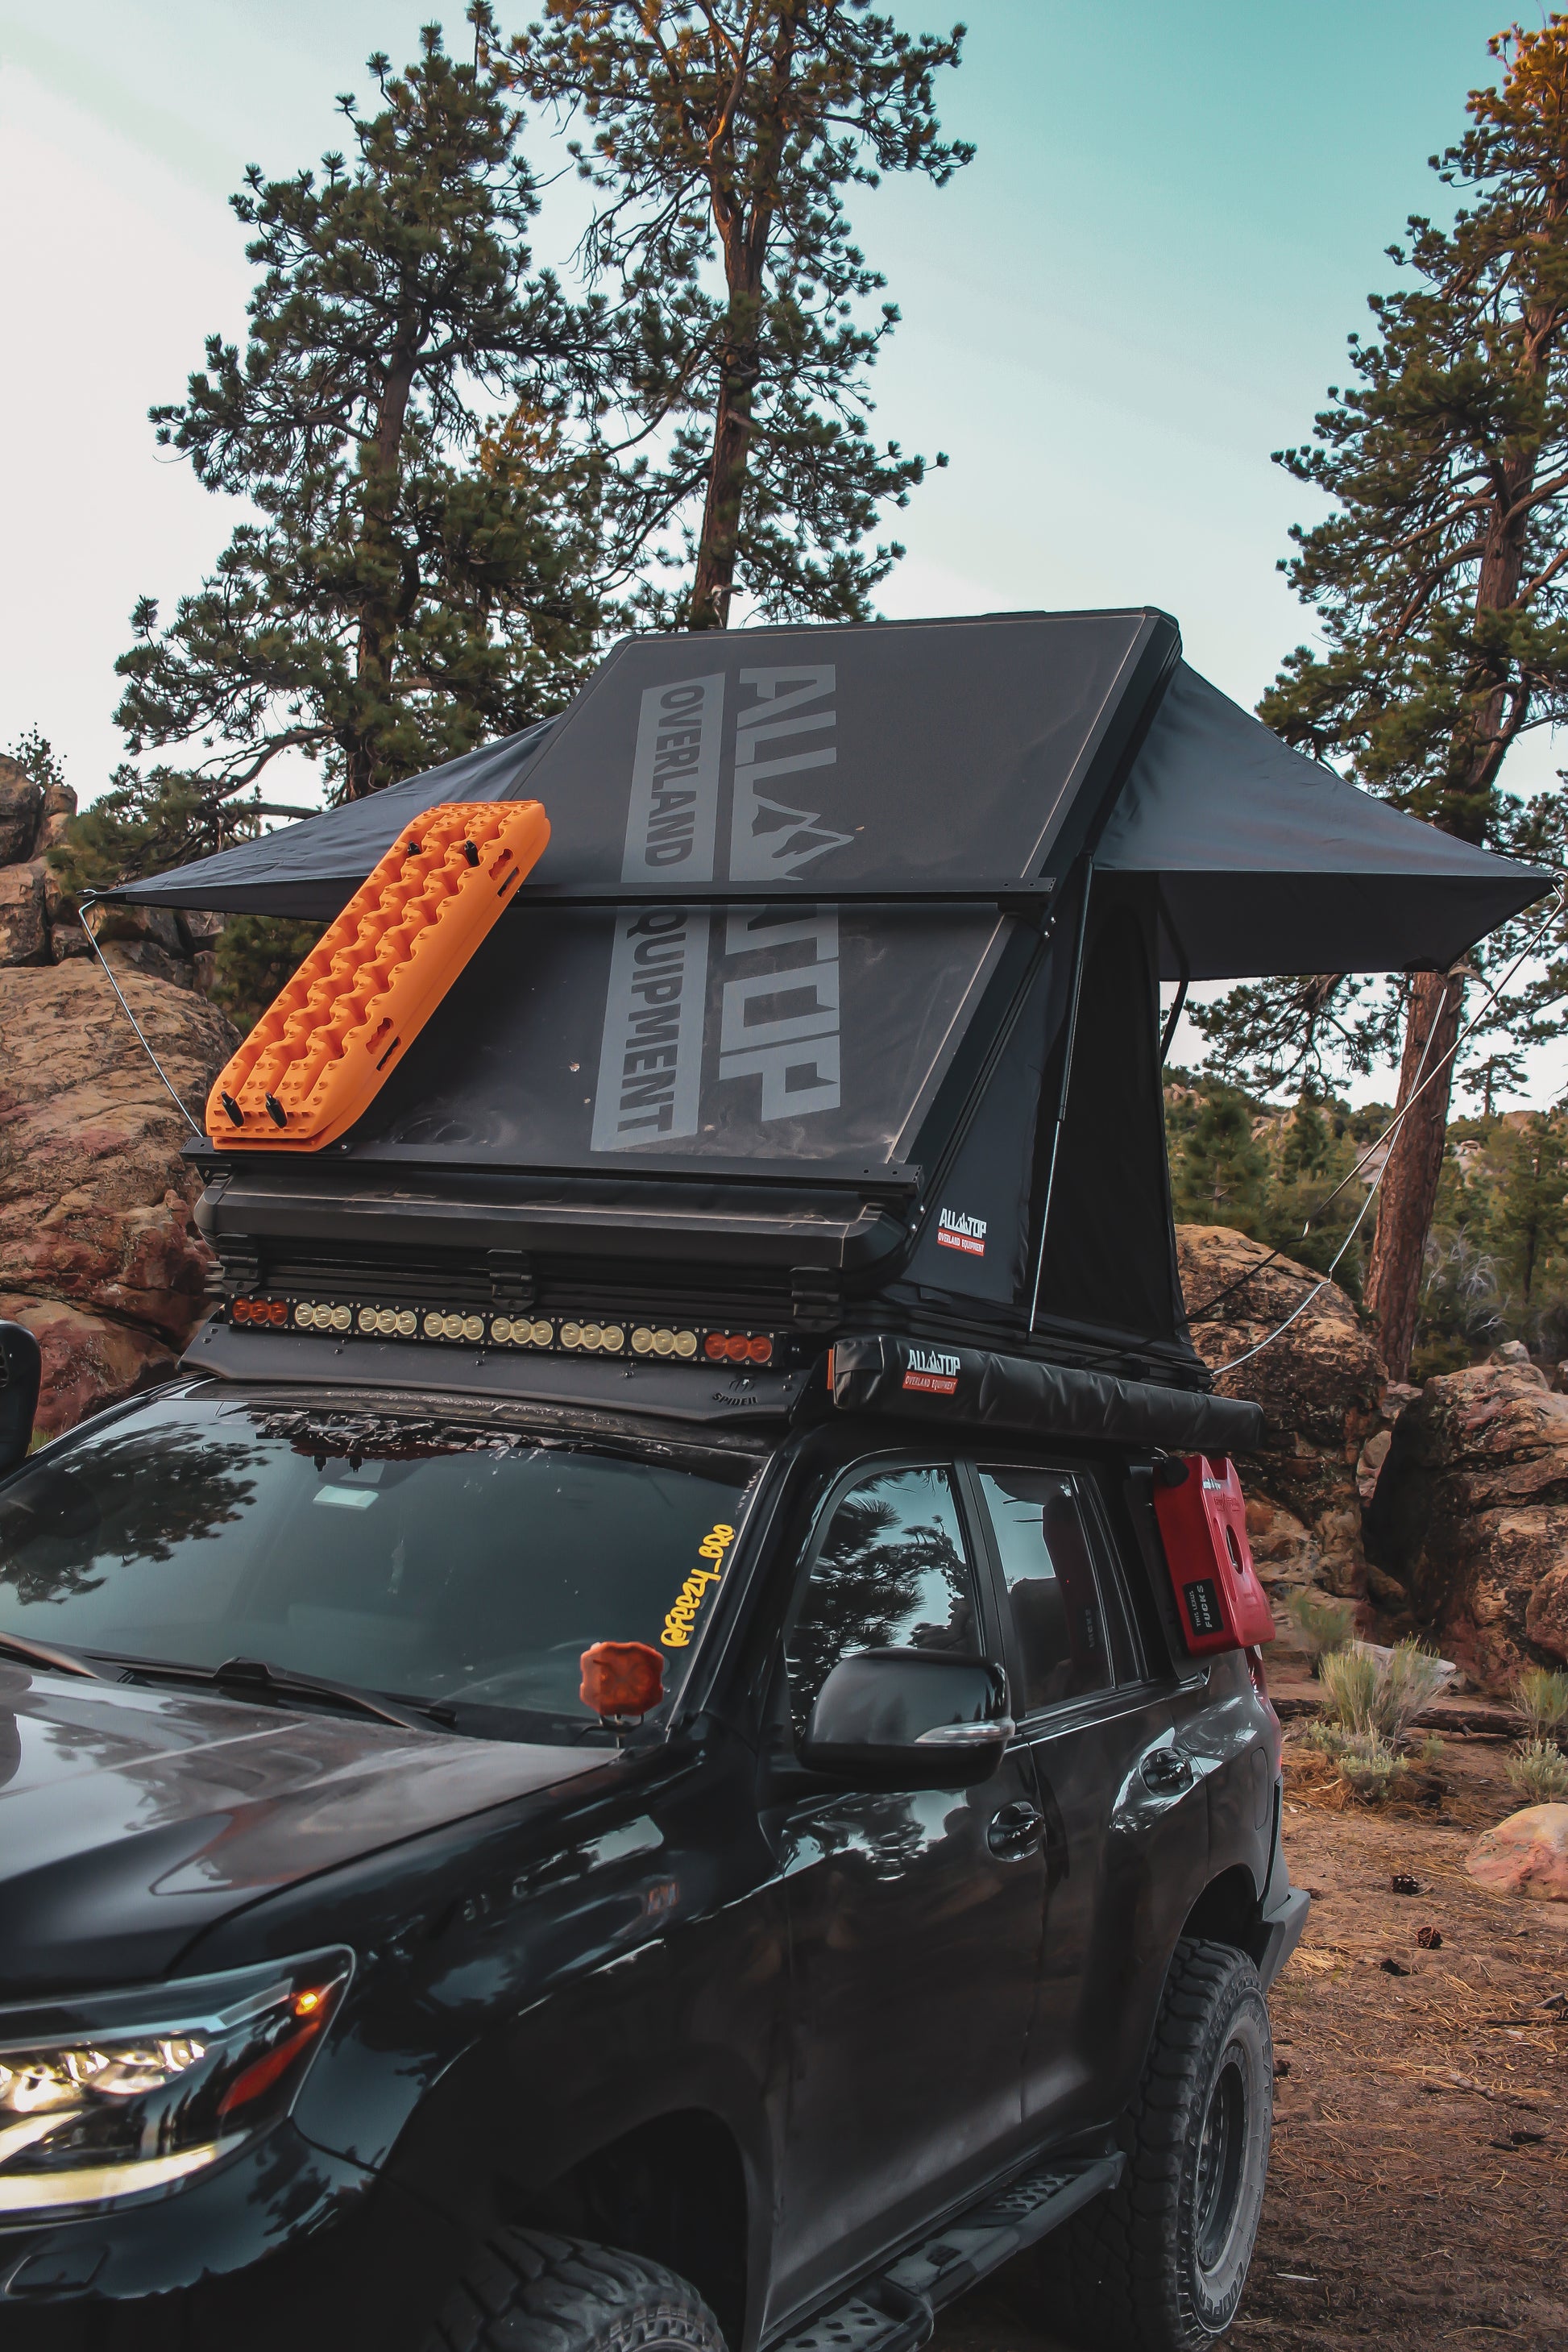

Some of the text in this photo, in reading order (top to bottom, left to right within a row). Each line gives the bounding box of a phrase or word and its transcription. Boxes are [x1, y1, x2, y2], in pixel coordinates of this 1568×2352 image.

[616, 685, 705, 1133] OVERLAND QUIPMENT
[938, 1232, 985, 1252] OVERLAND EQUIPMENT
[905, 1375, 956, 1390] OVERLAND EQUIPMENT
[1197, 1585, 1213, 1628] FUCKS
